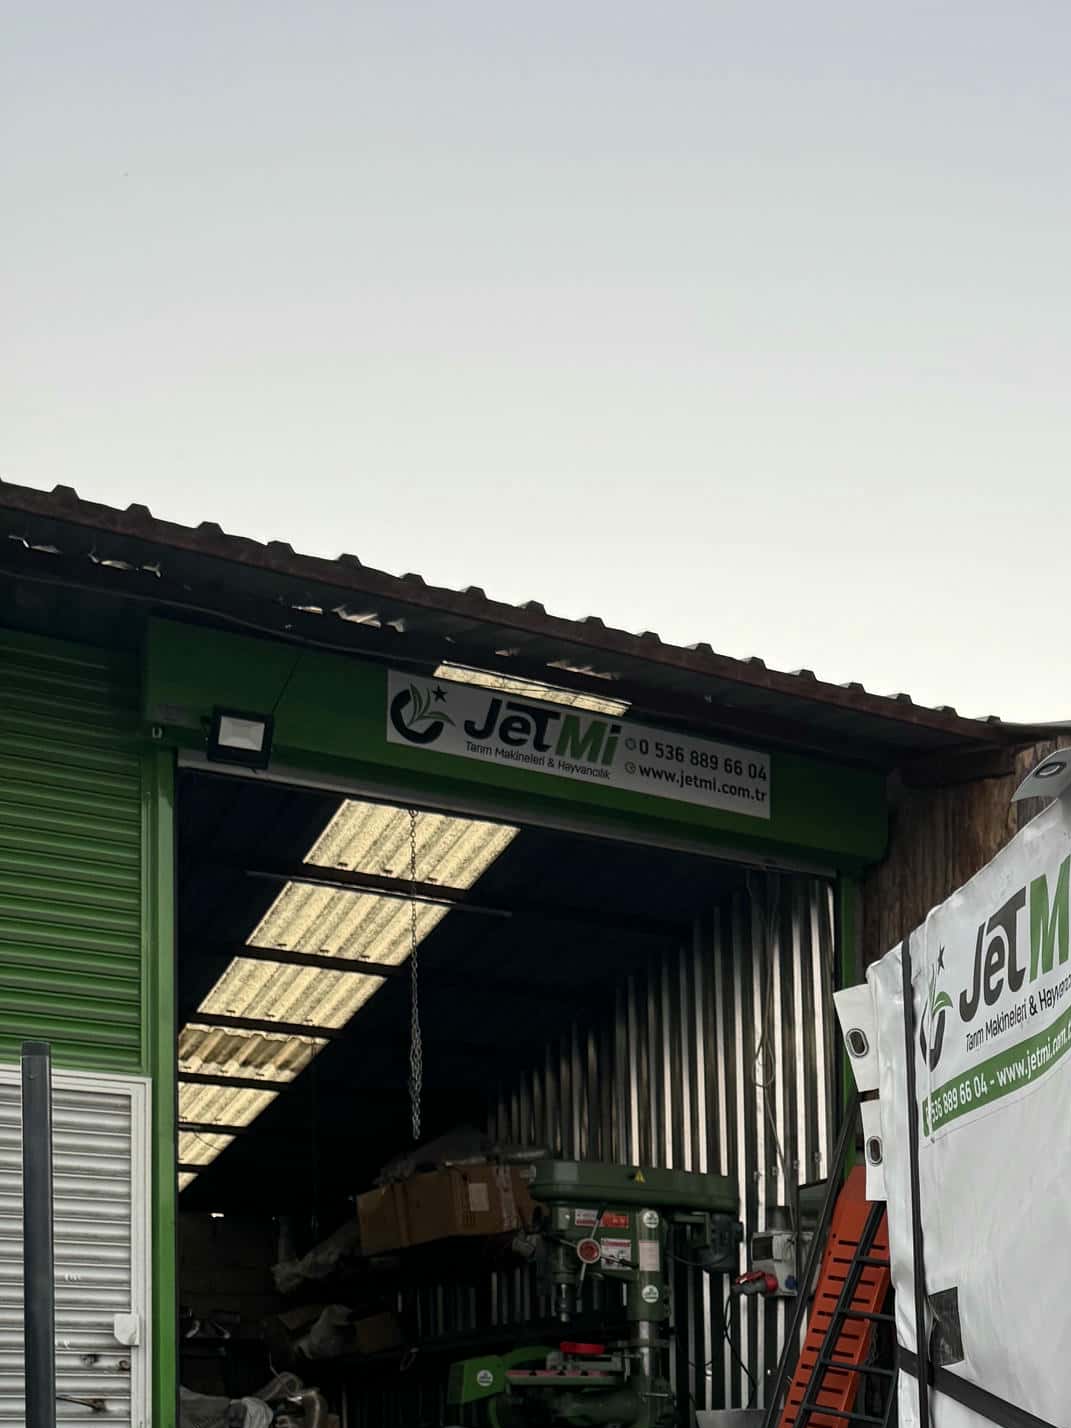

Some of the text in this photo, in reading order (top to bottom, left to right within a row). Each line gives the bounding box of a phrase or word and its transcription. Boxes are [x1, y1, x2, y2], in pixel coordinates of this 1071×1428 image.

[495, 747, 544, 768] Makineleri
[548, 758, 555, 768] &
[639, 739, 767, 780] 0 536 889 66 04
[639, 764, 767, 801] www.jetmi.com.tr
[986, 999, 1027, 1040] Makineleri
[1030, 995, 1038, 1016] &
[943, 1088, 958, 1113] 889
[960, 1081, 972, 1104] 66
[974, 1072, 988, 1098] 04
